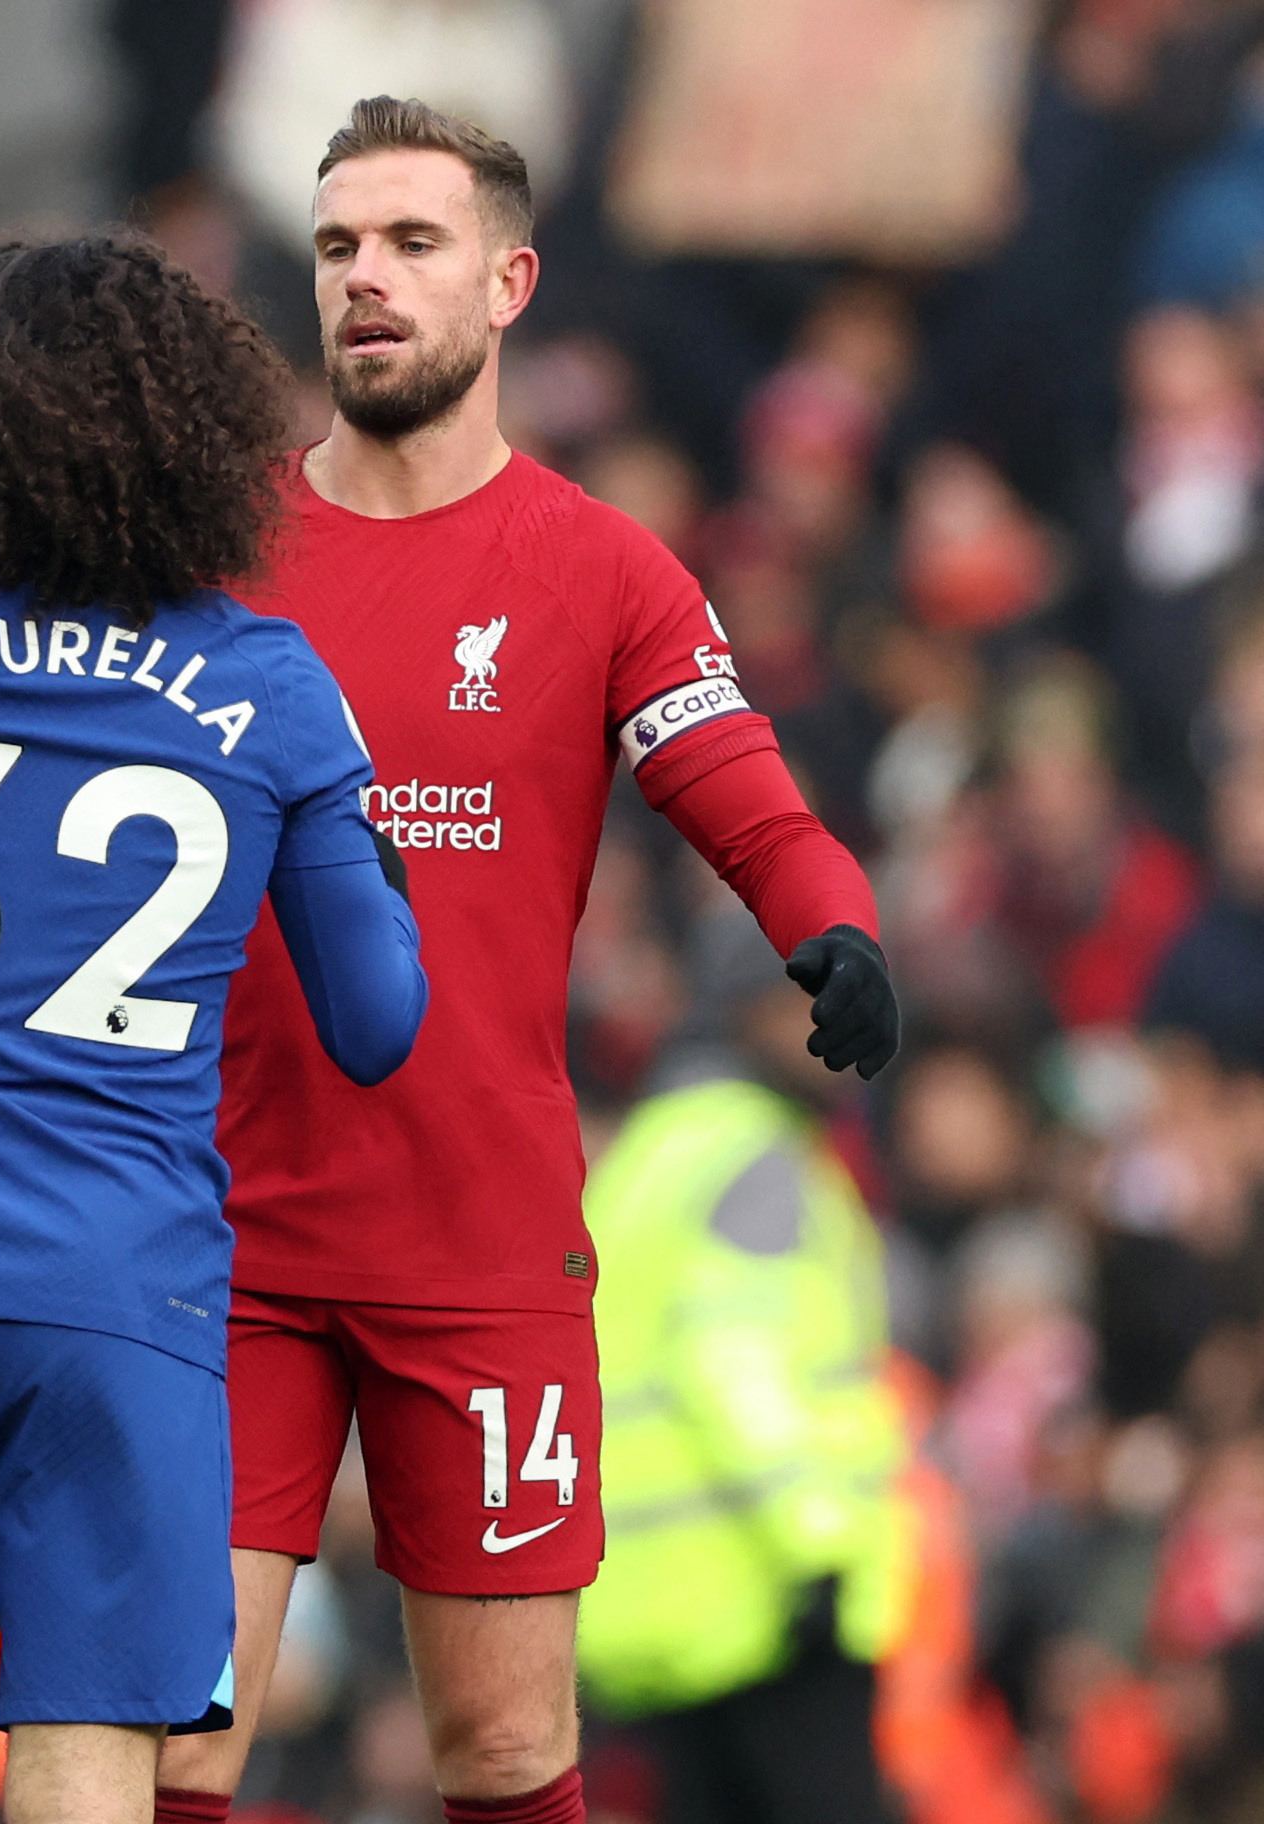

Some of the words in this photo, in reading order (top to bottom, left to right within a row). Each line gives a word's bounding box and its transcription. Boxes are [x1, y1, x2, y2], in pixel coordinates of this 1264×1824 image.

[365, 778, 493, 815] ndard
[376, 813, 502, 851] rtered
[467, 1384, 578, 1508] 14
